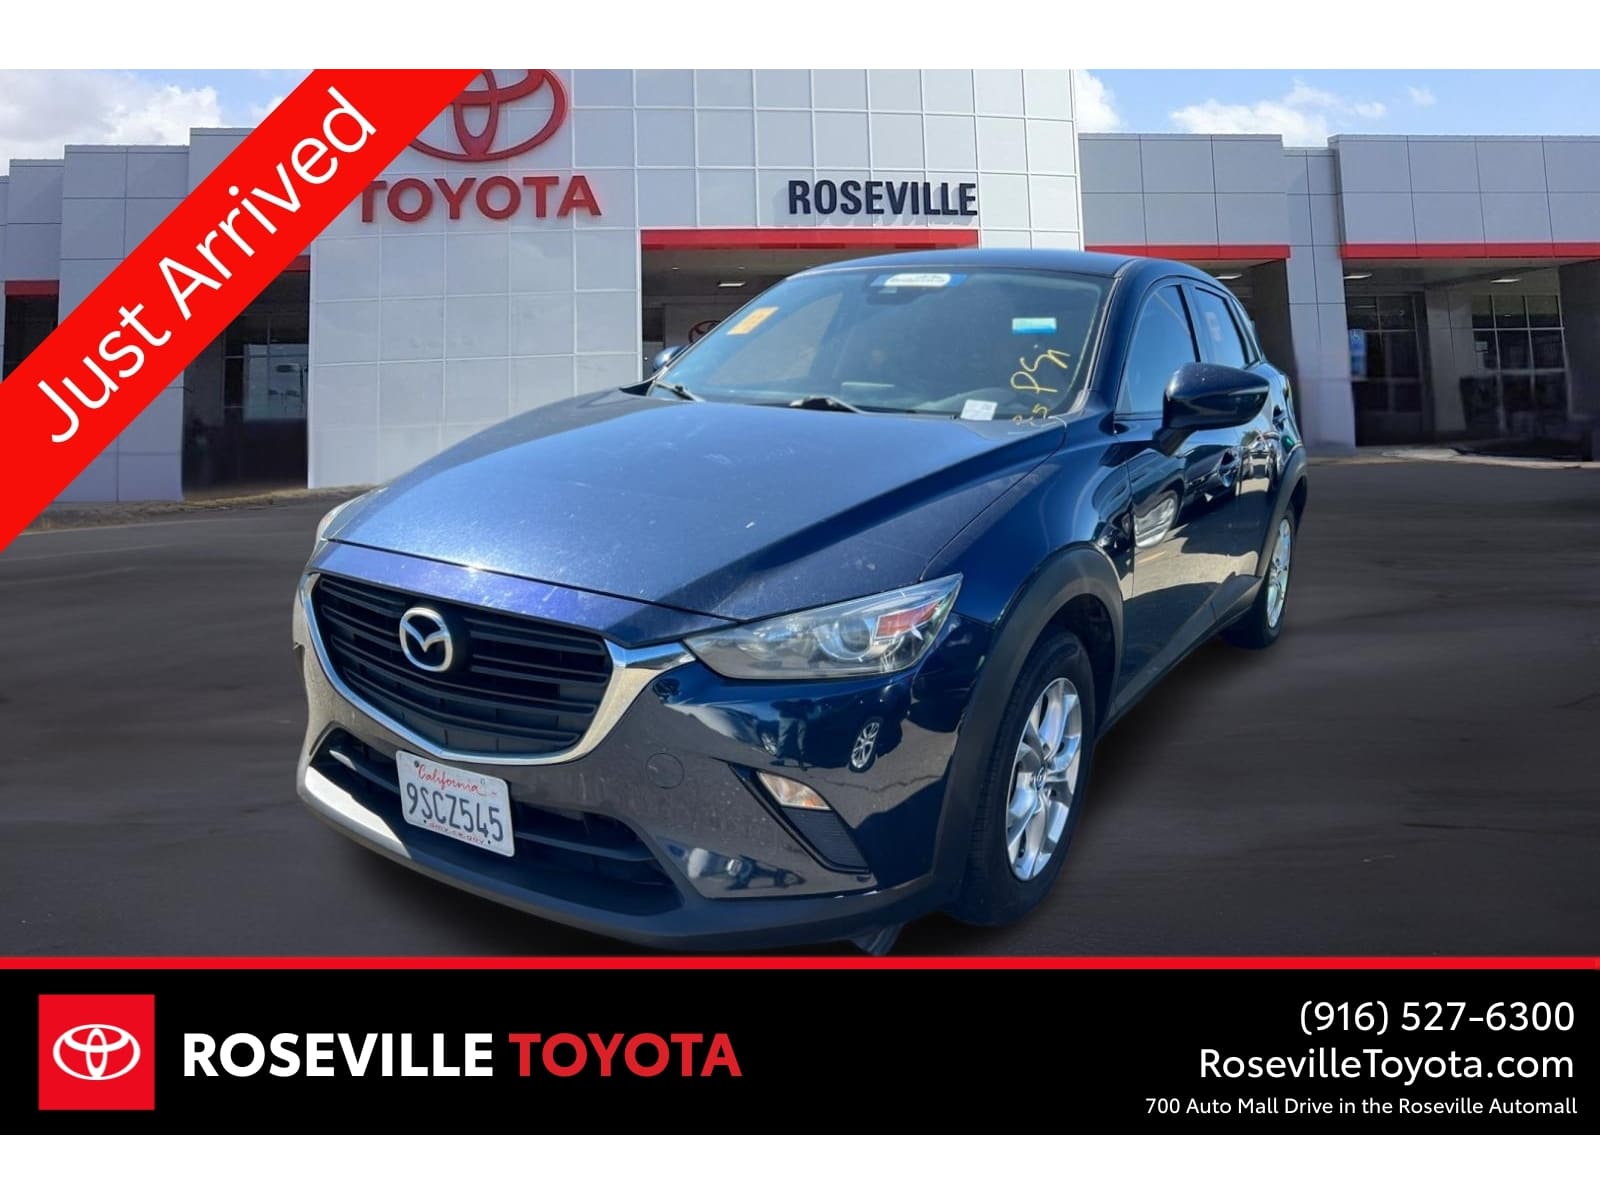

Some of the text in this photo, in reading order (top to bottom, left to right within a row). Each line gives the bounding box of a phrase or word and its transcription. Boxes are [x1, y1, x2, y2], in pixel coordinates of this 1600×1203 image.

[360, 175, 602, 224] TOYOTA
[788, 180, 978, 216] ROSEVILLE
[416, 763, 484, 794] California
[406, 782, 504, 842] 9SCZ545
